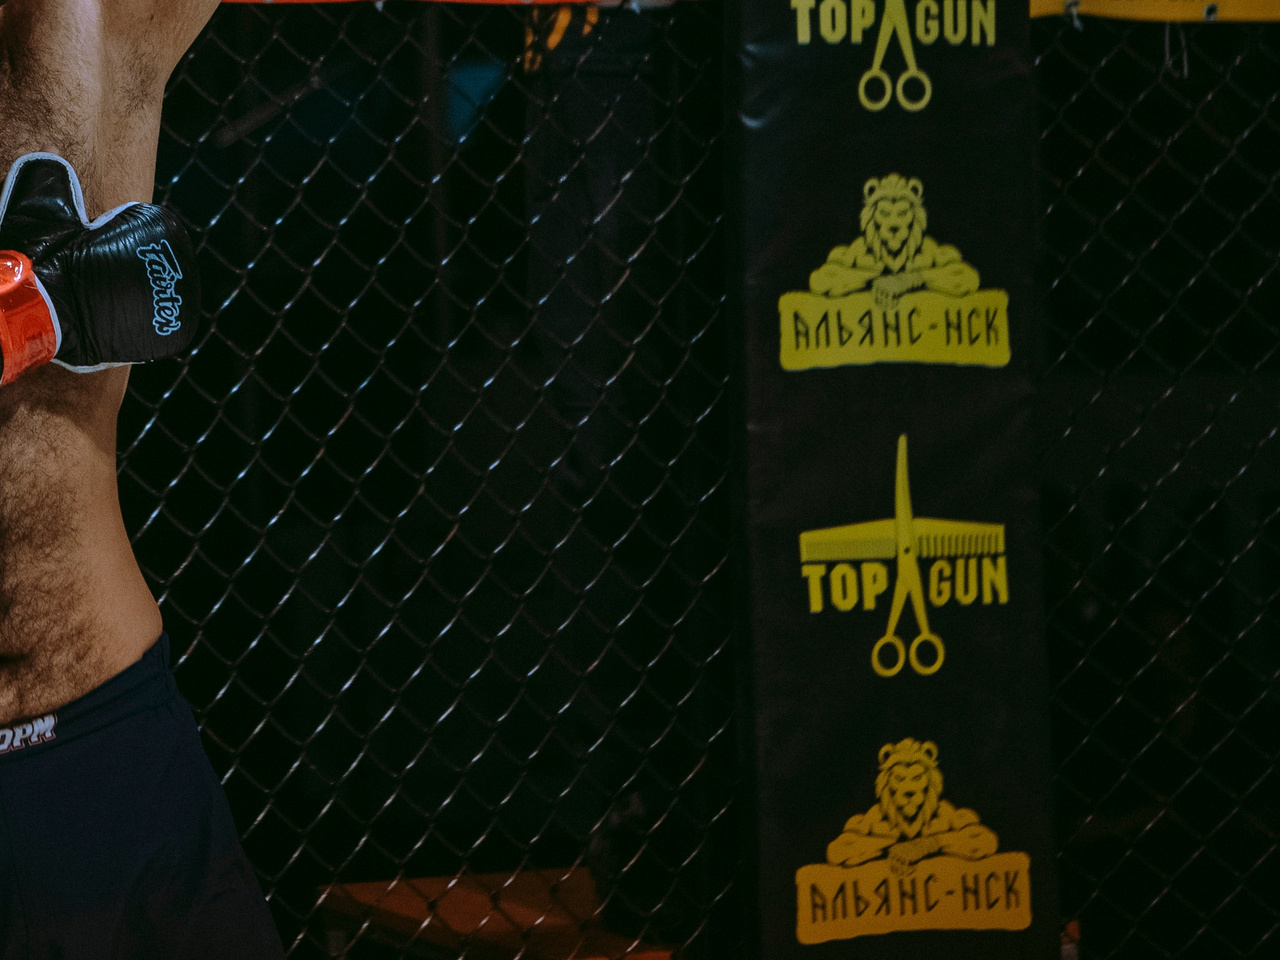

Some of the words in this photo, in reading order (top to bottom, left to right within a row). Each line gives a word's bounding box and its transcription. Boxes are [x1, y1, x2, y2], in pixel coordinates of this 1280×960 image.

[793, 306, 999, 351] АЛЬЯНС-НСК
[801, 561, 888, 613] TOP
[928, 556, 1009, 608] GUN
[810, 870, 1020, 924] АЛЬЯНС-НСК
